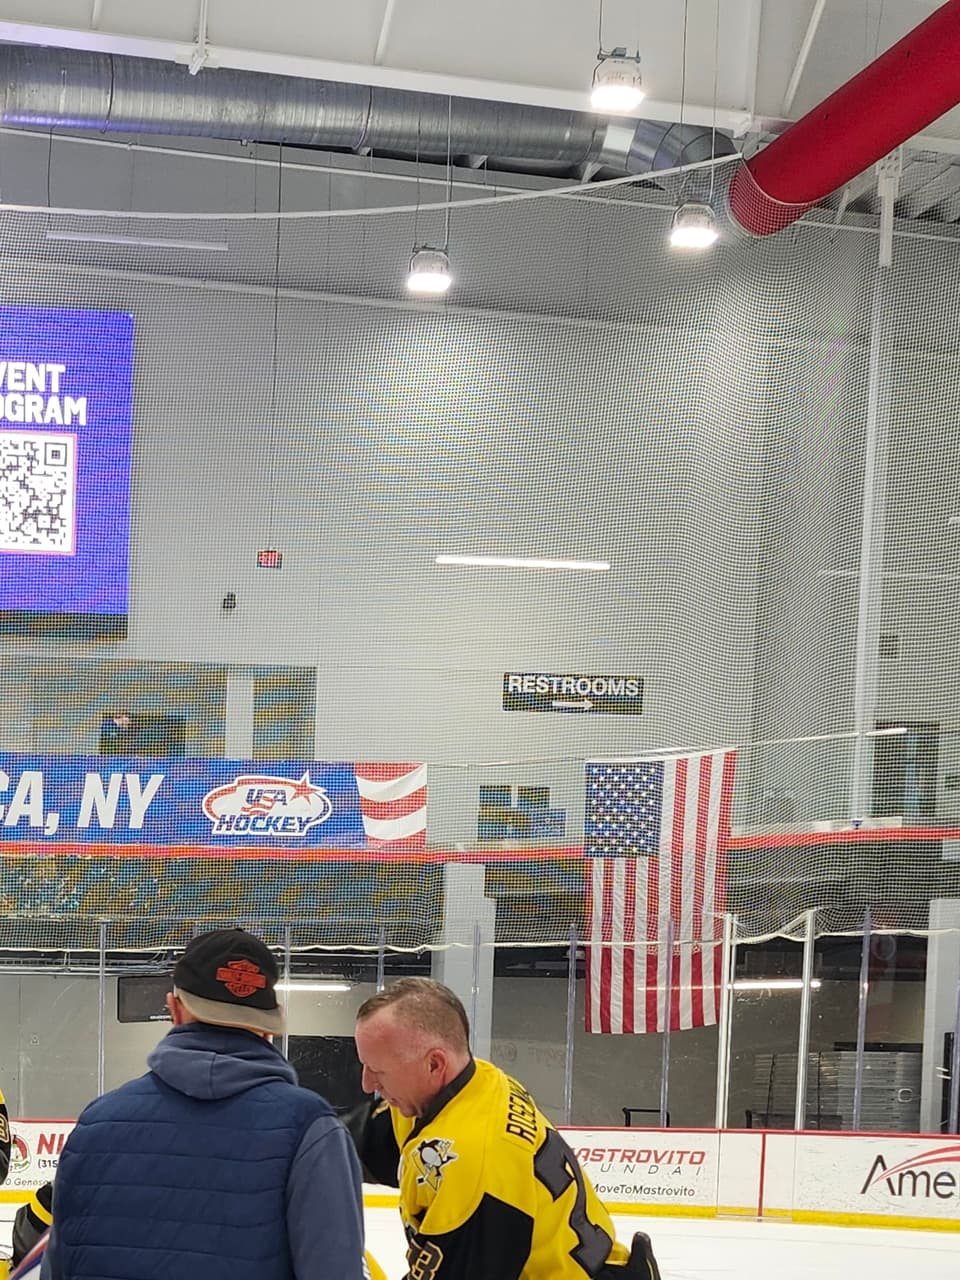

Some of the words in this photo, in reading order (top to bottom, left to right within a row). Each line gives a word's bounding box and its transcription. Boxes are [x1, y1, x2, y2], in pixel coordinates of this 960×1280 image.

[507, 674, 640, 697] RESTROOMS
[77, 772, 166, 829] NY
[245, 788, 288, 808] USA
[215, 814, 313, 833] HOCKEY
[580, 1163, 702, 1177] UNDAI
[860, 1154, 959, 1200] Ame
